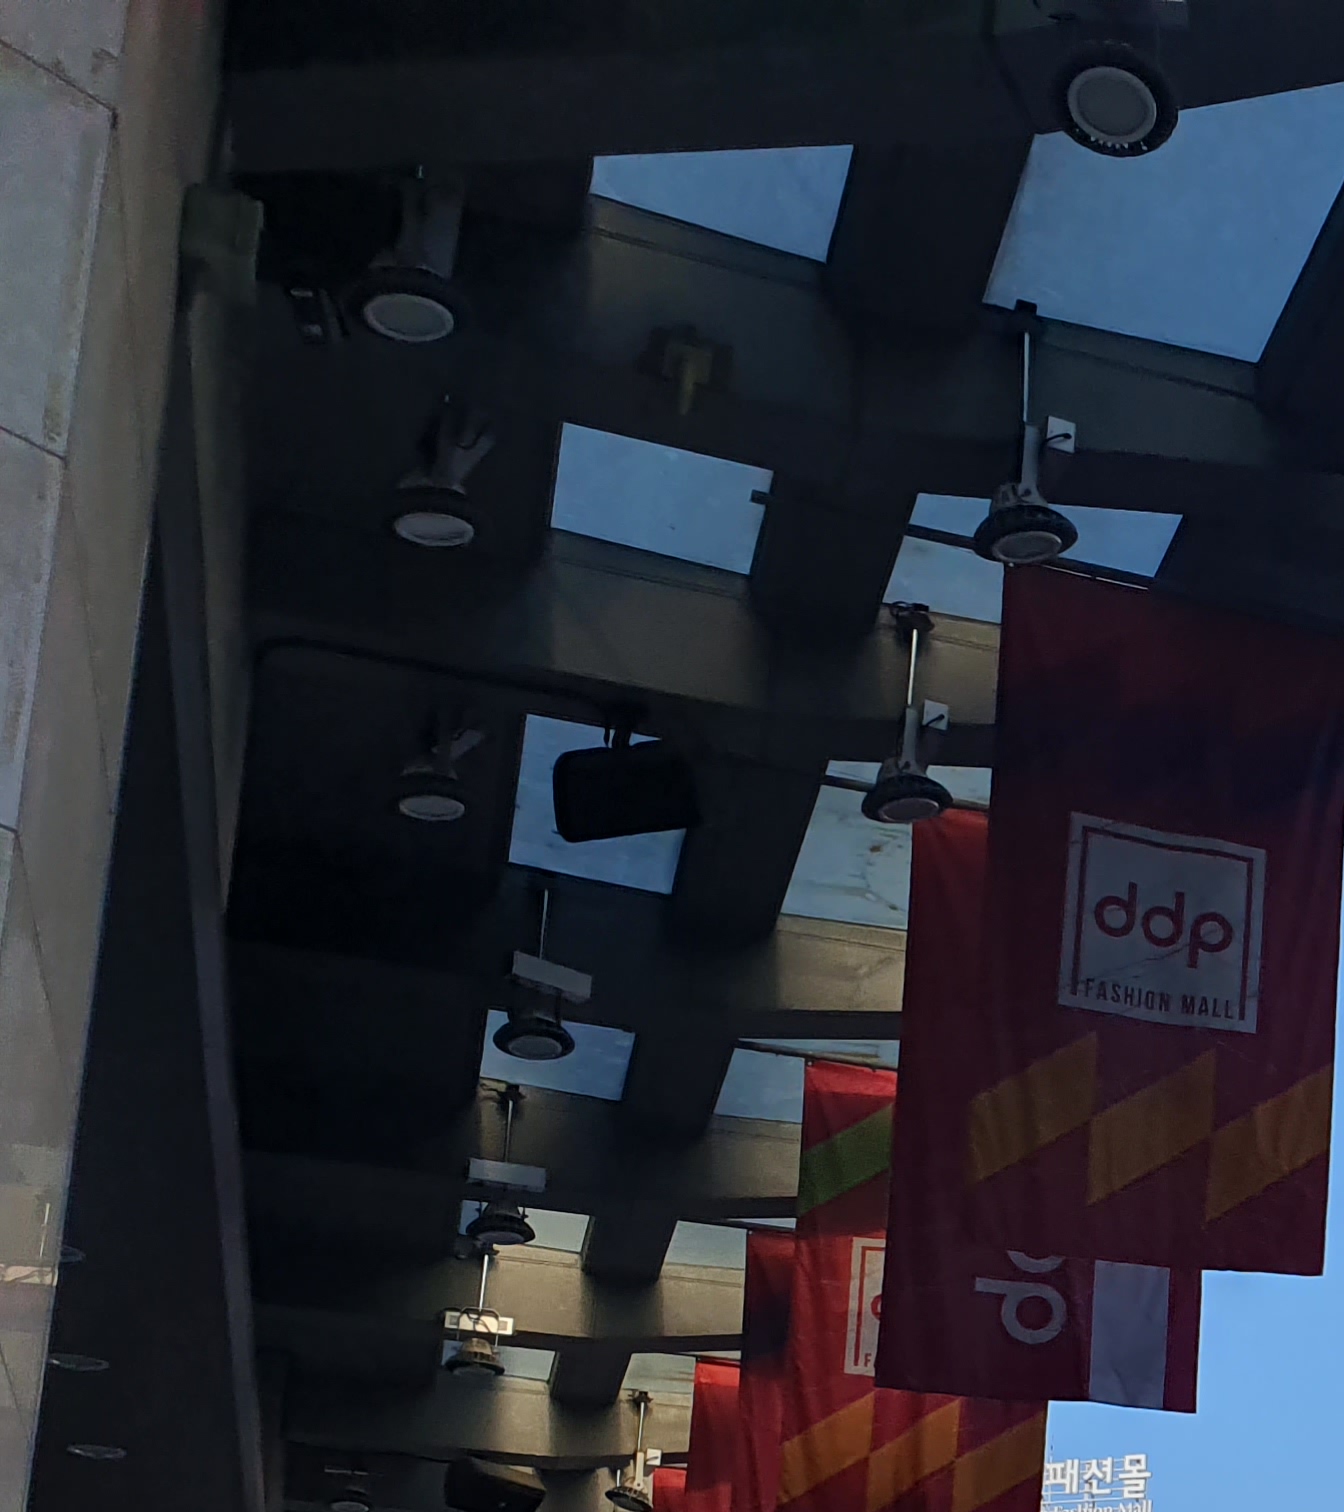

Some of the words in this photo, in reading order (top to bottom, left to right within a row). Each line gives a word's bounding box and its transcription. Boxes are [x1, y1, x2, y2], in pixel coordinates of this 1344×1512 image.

[1094, 882, 1234, 968] ddp
[1084, 977, 1172, 1013] FASHION
[1179, 994, 1236, 1021] MALL
[1045, 1454, 1152, 1499] 패션몰
